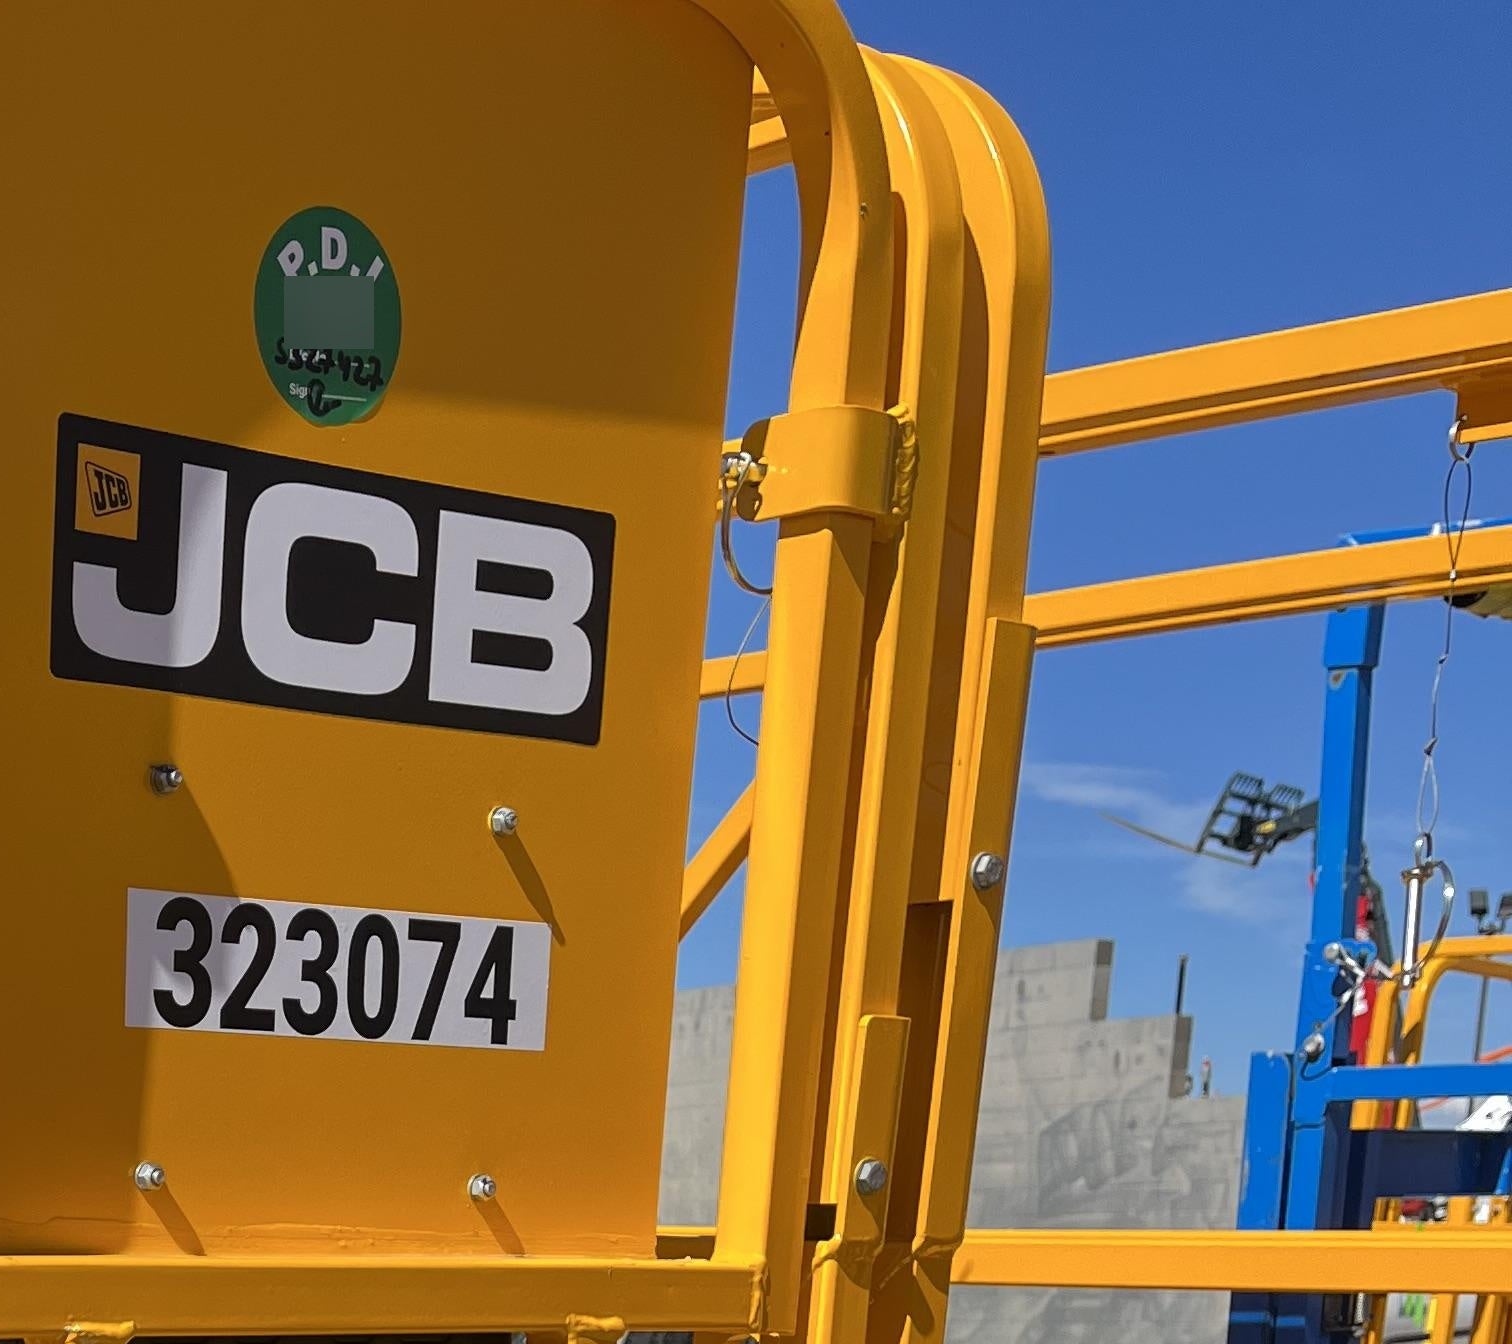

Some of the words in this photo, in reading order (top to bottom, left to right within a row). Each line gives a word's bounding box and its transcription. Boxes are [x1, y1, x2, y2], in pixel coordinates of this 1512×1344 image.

[88, 463, 130, 515] JCB
[71, 461, 596, 716] JCB
[152, 895, 517, 1045] 323074
